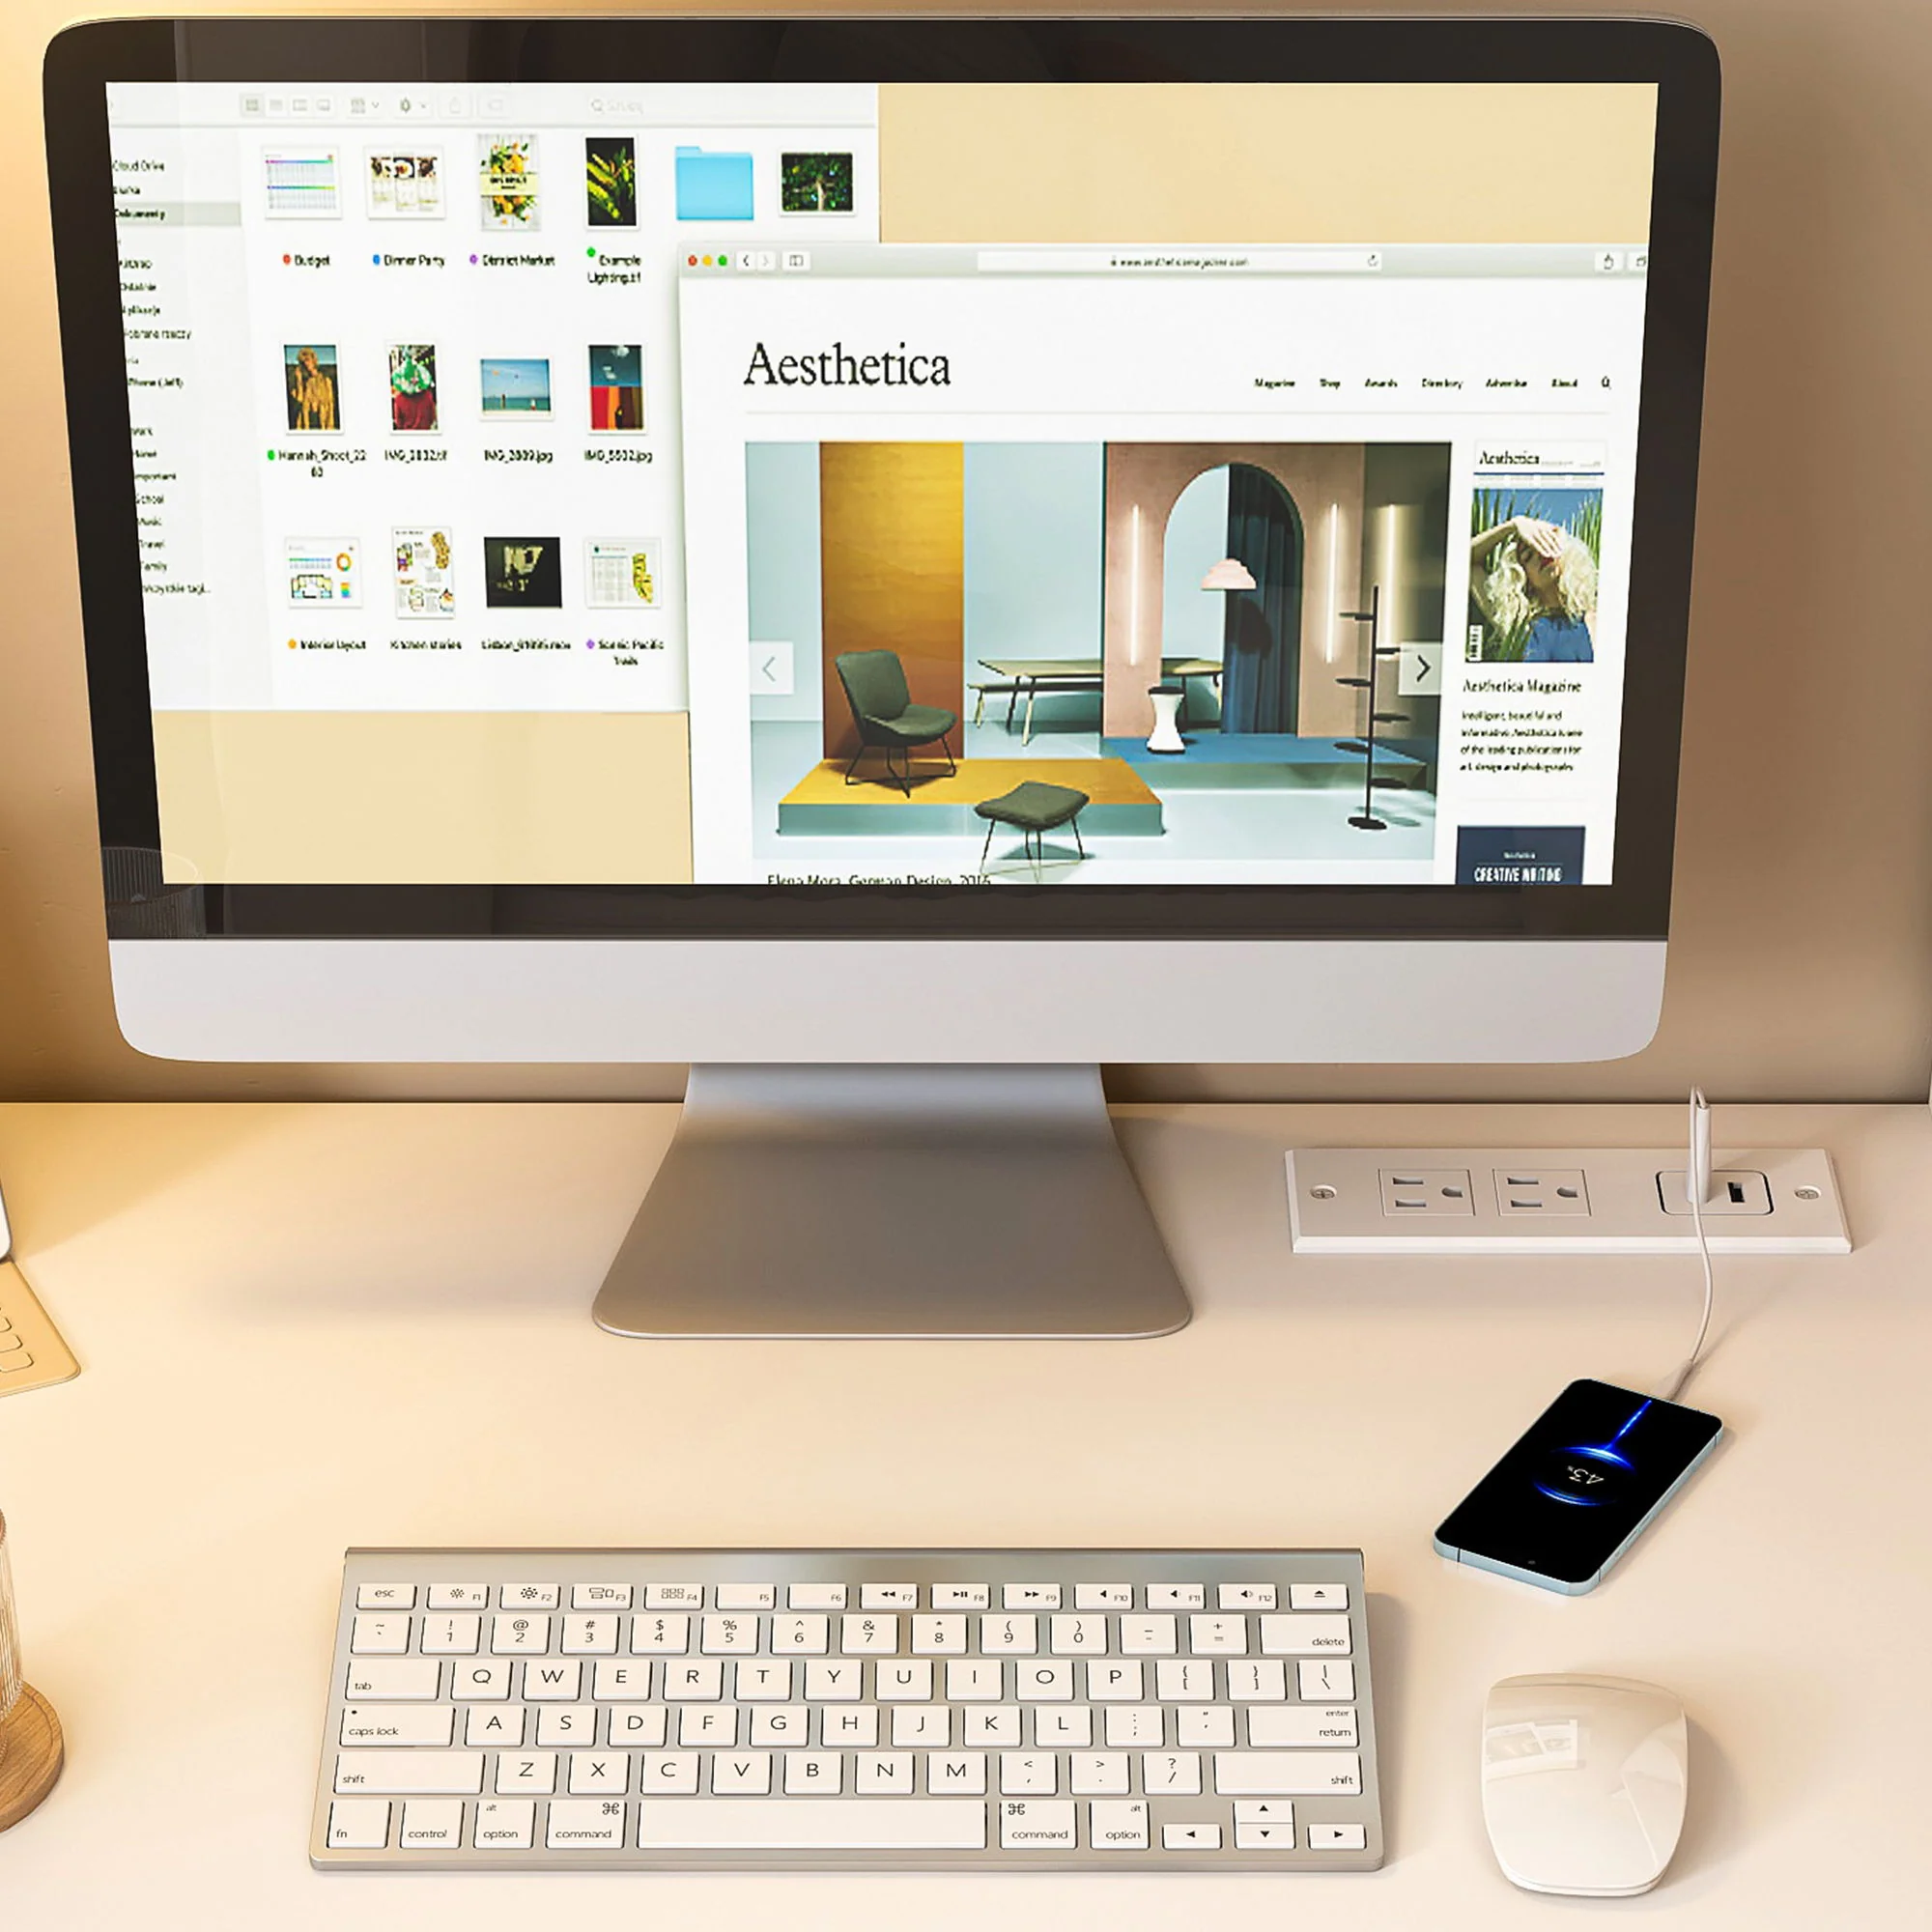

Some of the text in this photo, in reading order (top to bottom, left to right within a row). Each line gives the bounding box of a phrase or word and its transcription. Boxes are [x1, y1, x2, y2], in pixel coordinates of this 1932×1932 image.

[295, 254, 330, 268] Budget
[384, 254, 445, 269] Dinner Party
[482, 254, 555, 267] District Market
[599, 254, 641, 268] Example
[743, 341, 952, 385] Aesthetica
[1254, 378, 1296, 390] Magazine
[1421, 378, 1463, 390] Directory
[1479, 450, 1540, 466] Aesthetica
[1463, 678, 1582, 695] Aesthetica Magazine
[374, 1589, 395, 1599] esc
[471, 1593, 482, 1602] F1
[540, 1593, 554, 1603] F2
[614, 1593, 627, 1603] F3
[686, 1593, 697, 1602] F4
[759, 1593, 770, 1603] F5
[830, 1593, 842, 1603] F6
[901, 1593, 914, 1603] F7
[973, 1593, 985, 1603] F8
[1045, 1594, 1058, 1603] F9
[1113, 1594, 1129, 1603] F10
[1187, 1594, 1201, 1603] F11
[1258, 1594, 1273, 1603] F12
[514, 1632, 526, 1643] 2
[584, 1632, 595, 1644] 3
[653, 1632, 664, 1643] 4
[724, 1632, 735, 1644] 5
[794, 1632, 805, 1644] 6
[864, 1632, 874, 1643] 7
[934, 1632, 945, 1644] 8
[1004, 1630, 1014, 1644] 9
[1072, 1630, 1085, 1644] 0
[1311, 1637, 1346, 1646] delete
[471, 1668, 492, 1685] Q
[540, 1669, 565, 1684] W
[615, 1669, 627, 1684] E
[686, 1669, 700, 1684] R
[756, 1669, 771, 1684] T
[827, 1669, 841, 1684] Y
[895, 1669, 912, 1685] U
[1035, 1669, 1056, 1685] O
[1109, 1669, 1122, 1685] P
[355, 1681, 373, 1690] tab
[485, 1715, 502, 1730] A
[559, 1715, 572, 1731] S
[627, 1715, 644, 1731] D
[701, 1715, 715, 1731] F
[770, 1715, 787, 1731] G
[841, 1715, 859, 1731] H
[916, 1715, 925, 1733] J
[984, 1716, 999, 1731] K
[1058, 1716, 1069, 1731] L
[348, 1726, 399, 1738] caps lock
[1319, 1728, 1352, 1737] return
[518, 1761, 534, 1777] Z
[590, 1762, 607, 1777] X
[660, 1761, 677, 1778] C
[733, 1762, 751, 1777] V
[806, 1762, 819, 1777] B
[876, 1762, 894, 1778] N
[946, 1763, 967, 1778] M
[342, 1774, 365, 1784] shift
[1330, 1775, 1353, 1785] shift
[485, 1804, 497, 1812] alt
[1130, 1804, 1142, 1813] alt
[335, 1828, 348, 1838] fn
[407, 1829, 448, 1839] control
[482, 1830, 519, 1841] option
[554, 1829, 612, 1839] command
[1011, 1830, 1069, 1840] command
[1105, 1830, 1141, 1841] option
